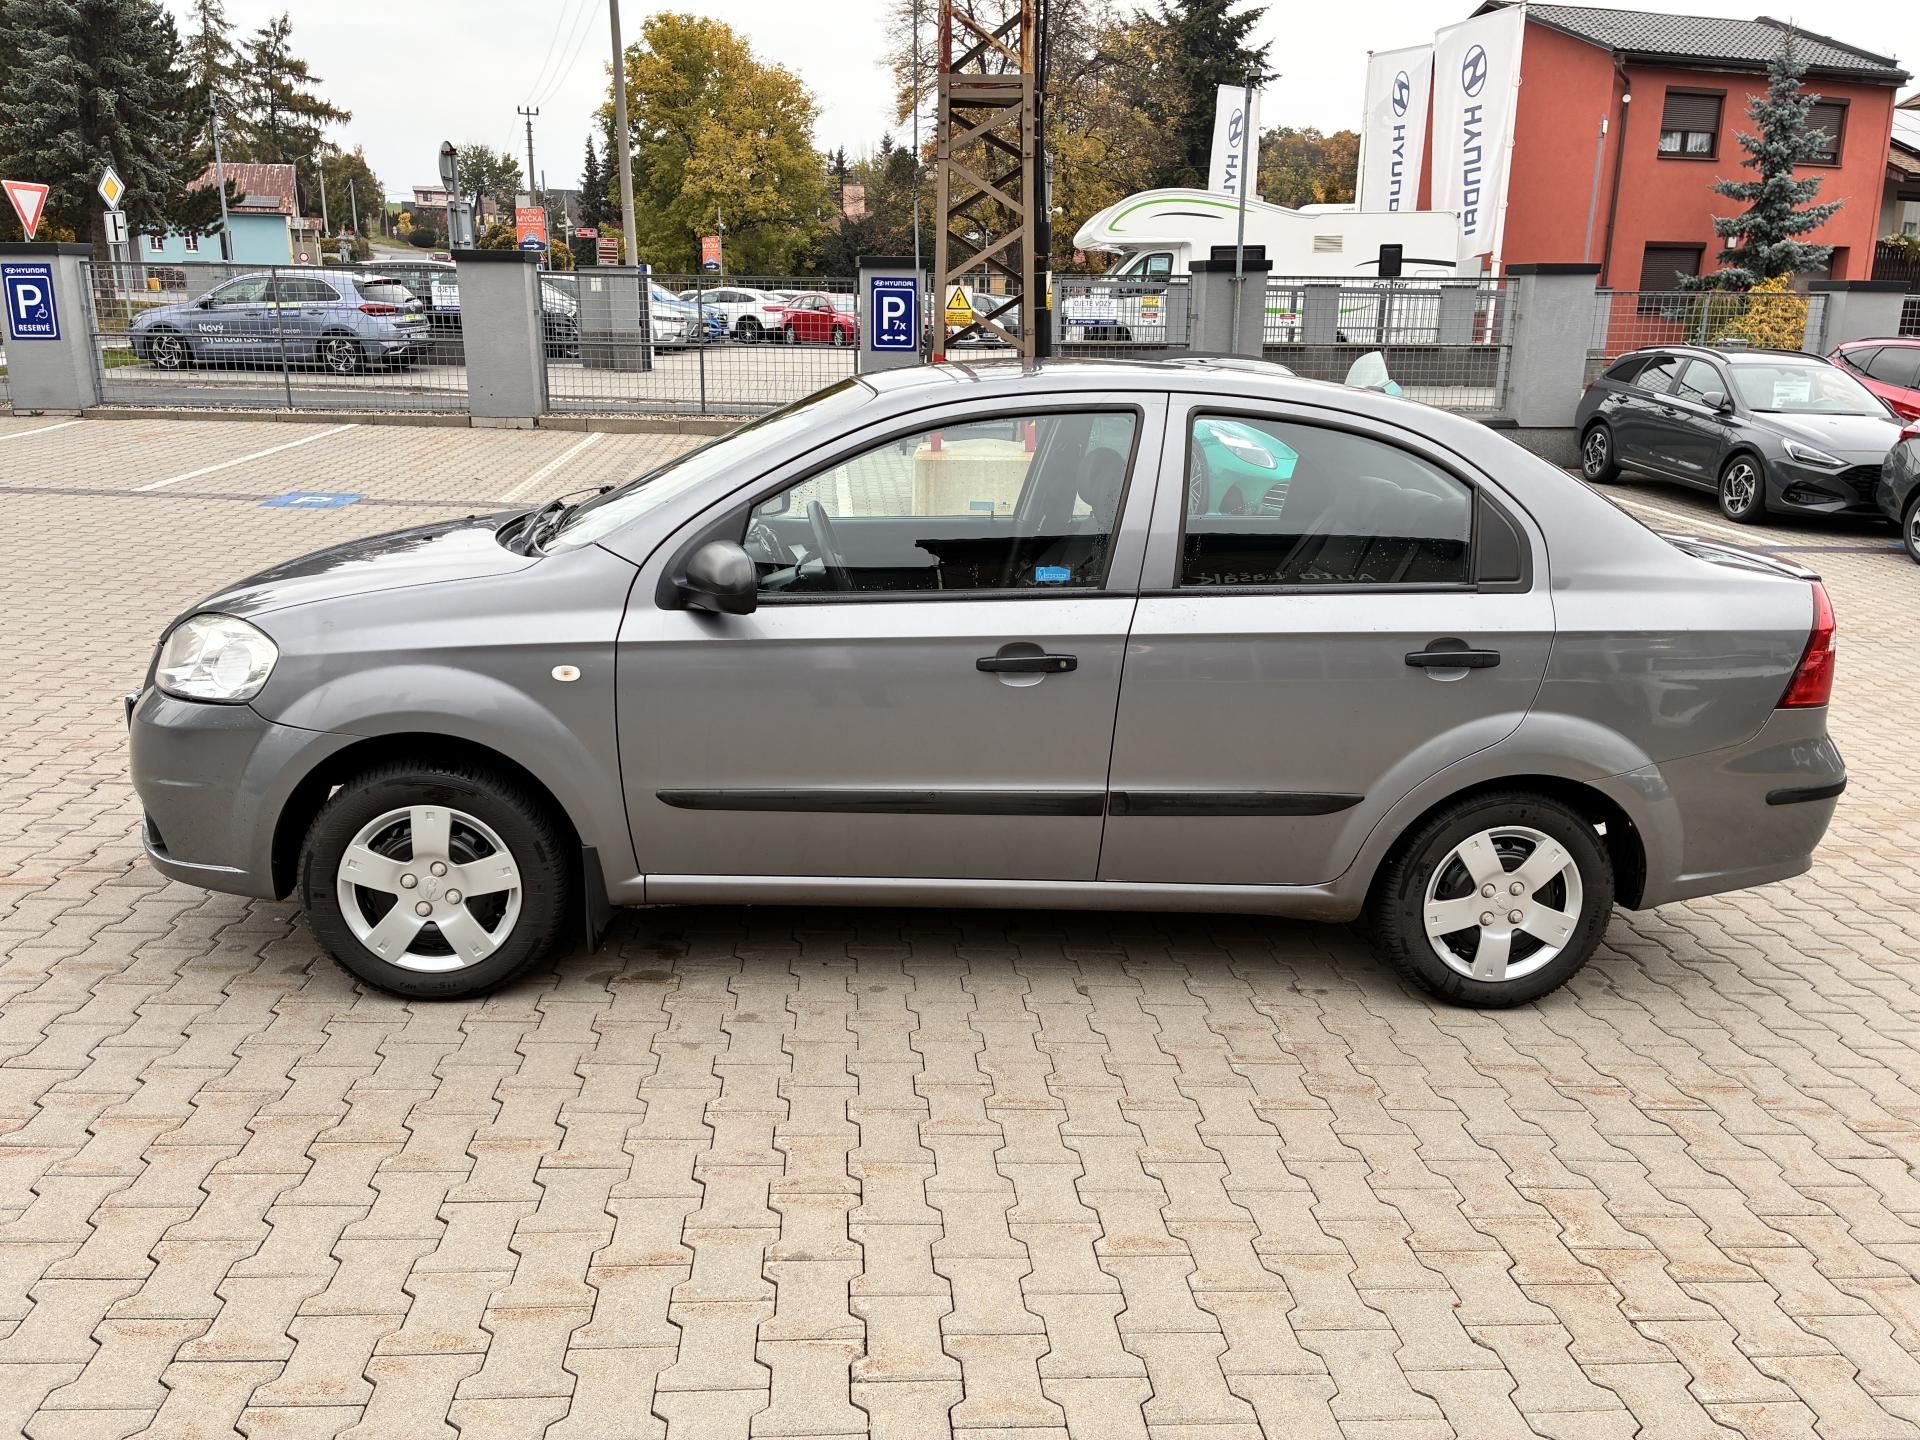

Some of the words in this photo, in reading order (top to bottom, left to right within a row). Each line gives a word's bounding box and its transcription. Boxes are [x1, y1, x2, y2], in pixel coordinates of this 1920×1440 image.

[517, 214, 542, 223] MYČKA
[16, 284, 42, 319] P
[882, 296, 906, 330] P
[18, 322, 51, 332] RESERVÉ
[892, 319, 907, 331] 7x
